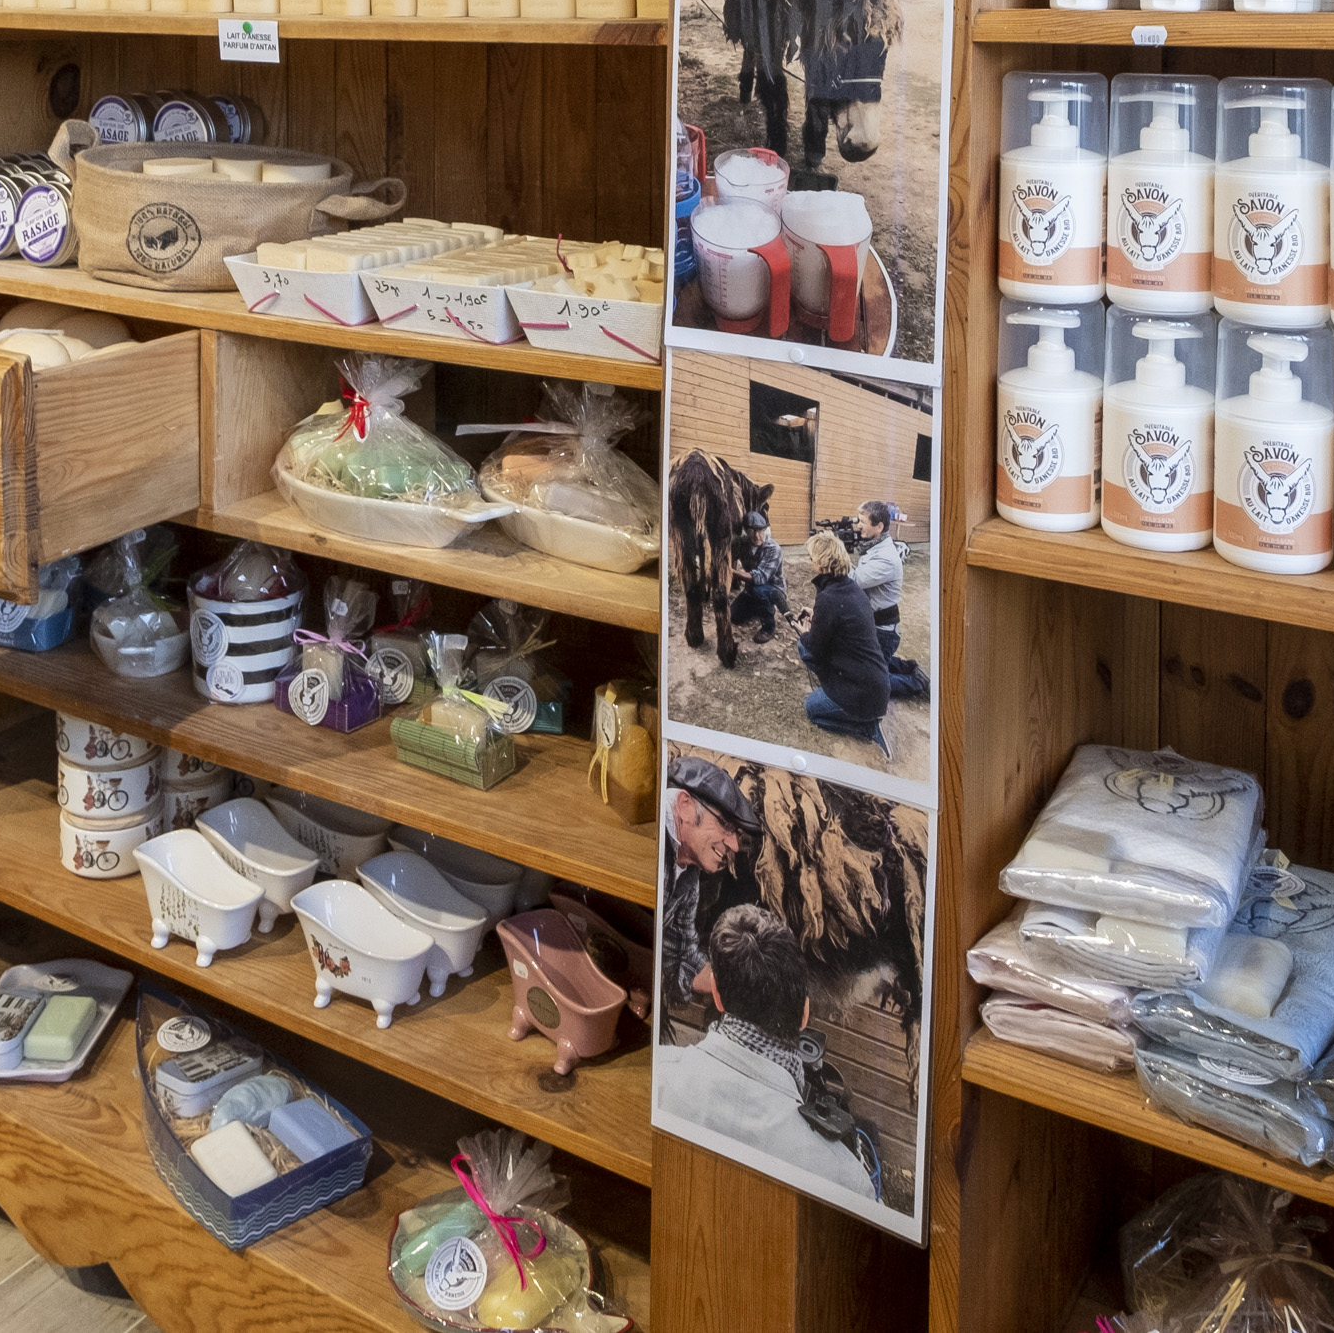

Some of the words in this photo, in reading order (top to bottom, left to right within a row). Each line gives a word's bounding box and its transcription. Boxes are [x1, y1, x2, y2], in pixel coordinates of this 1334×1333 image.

[226, 32, 240, 40] LAIT
[223, 41, 248, 49] PARFUM
[250, 43, 277, 51] D'ANTAN
[1018, 184, 1059, 201] SAVON
[21, 214, 61, 242] RASAGE
[1250, 445, 1299, 464] SAVON
